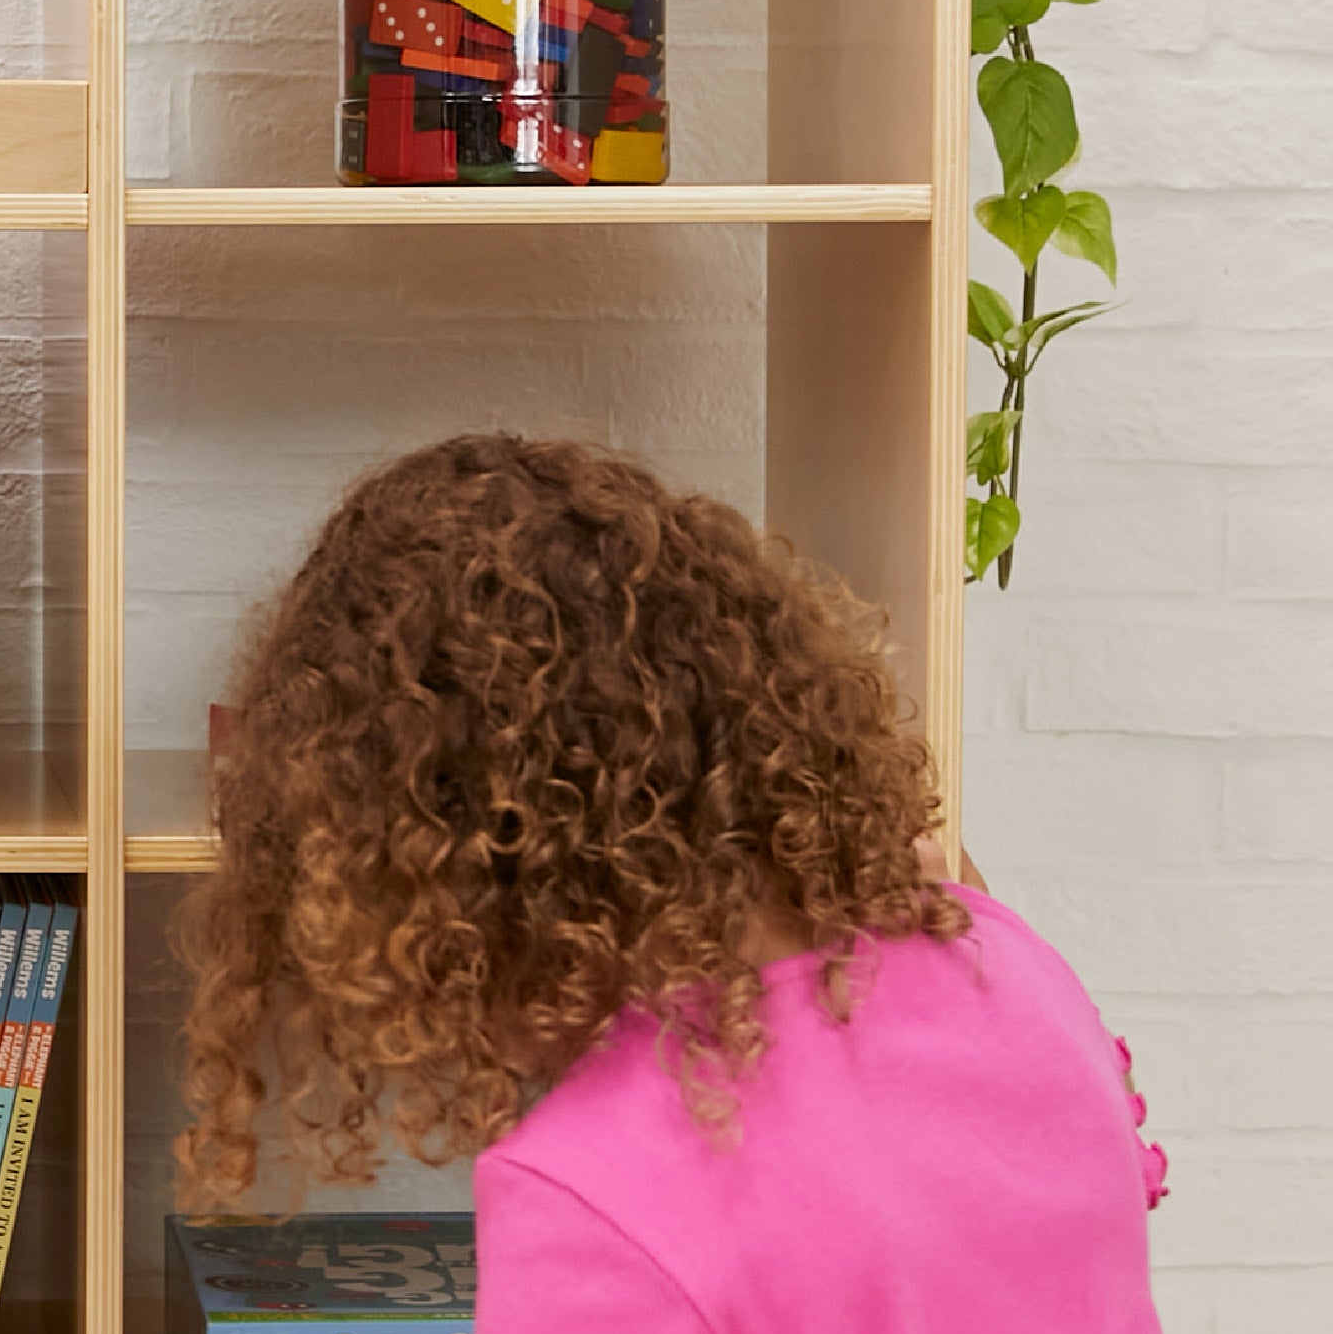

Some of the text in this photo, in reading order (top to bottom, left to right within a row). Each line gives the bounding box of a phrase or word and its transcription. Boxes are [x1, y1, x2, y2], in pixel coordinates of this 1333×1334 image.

[13, 928, 43, 998] Willems
[41, 929, 72, 999] Willems
[4, 1034, 25, 1088] ELEPHANT
[32, 1034, 52, 1088] ELEPHANT
[15, 1110, 32, 1134] AM
[0, 1140, 26, 1209] INVITED
